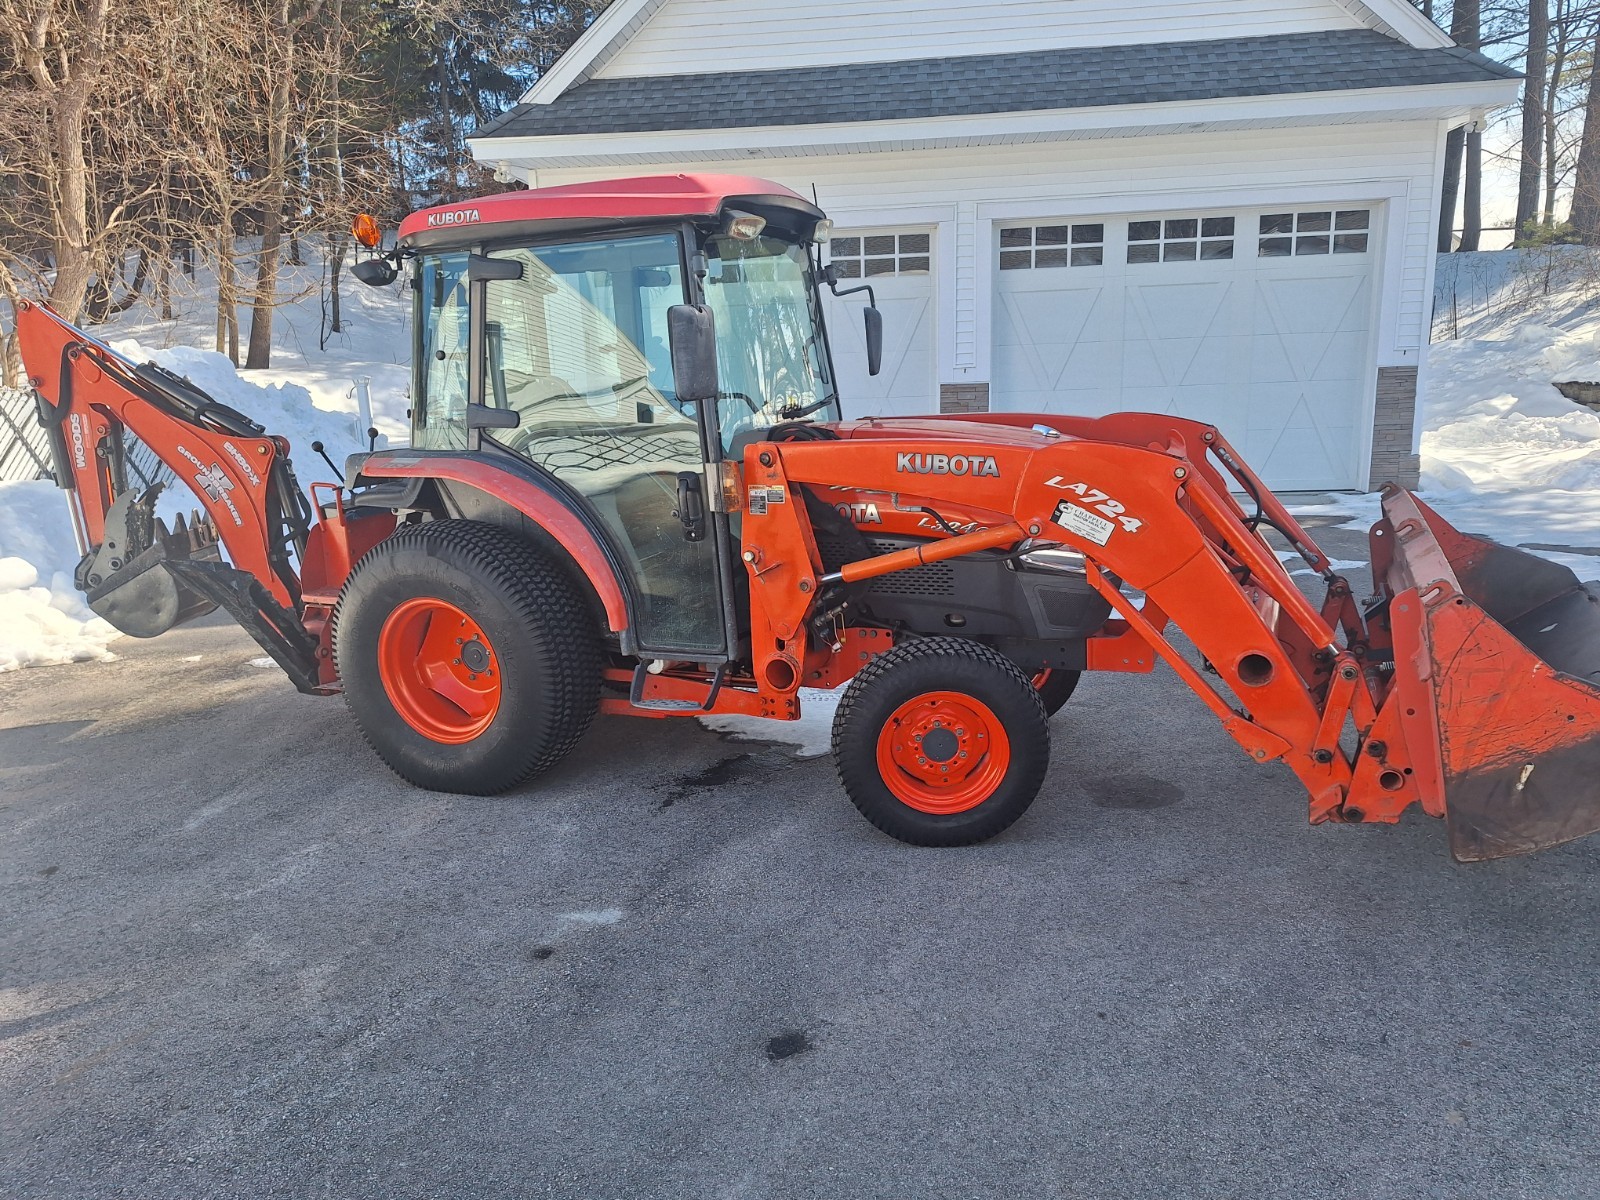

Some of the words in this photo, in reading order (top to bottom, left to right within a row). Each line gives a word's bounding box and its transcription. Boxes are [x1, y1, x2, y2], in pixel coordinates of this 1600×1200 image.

[427, 208, 481, 227] KUBOTA
[70, 413, 86, 468] WOODS
[896, 452, 1000, 477] KUBOTA
[177, 445, 243, 527] GROUNDBREAKER
[1044, 475, 1142, 533] LA724
[833, 501, 882, 524] OTA
